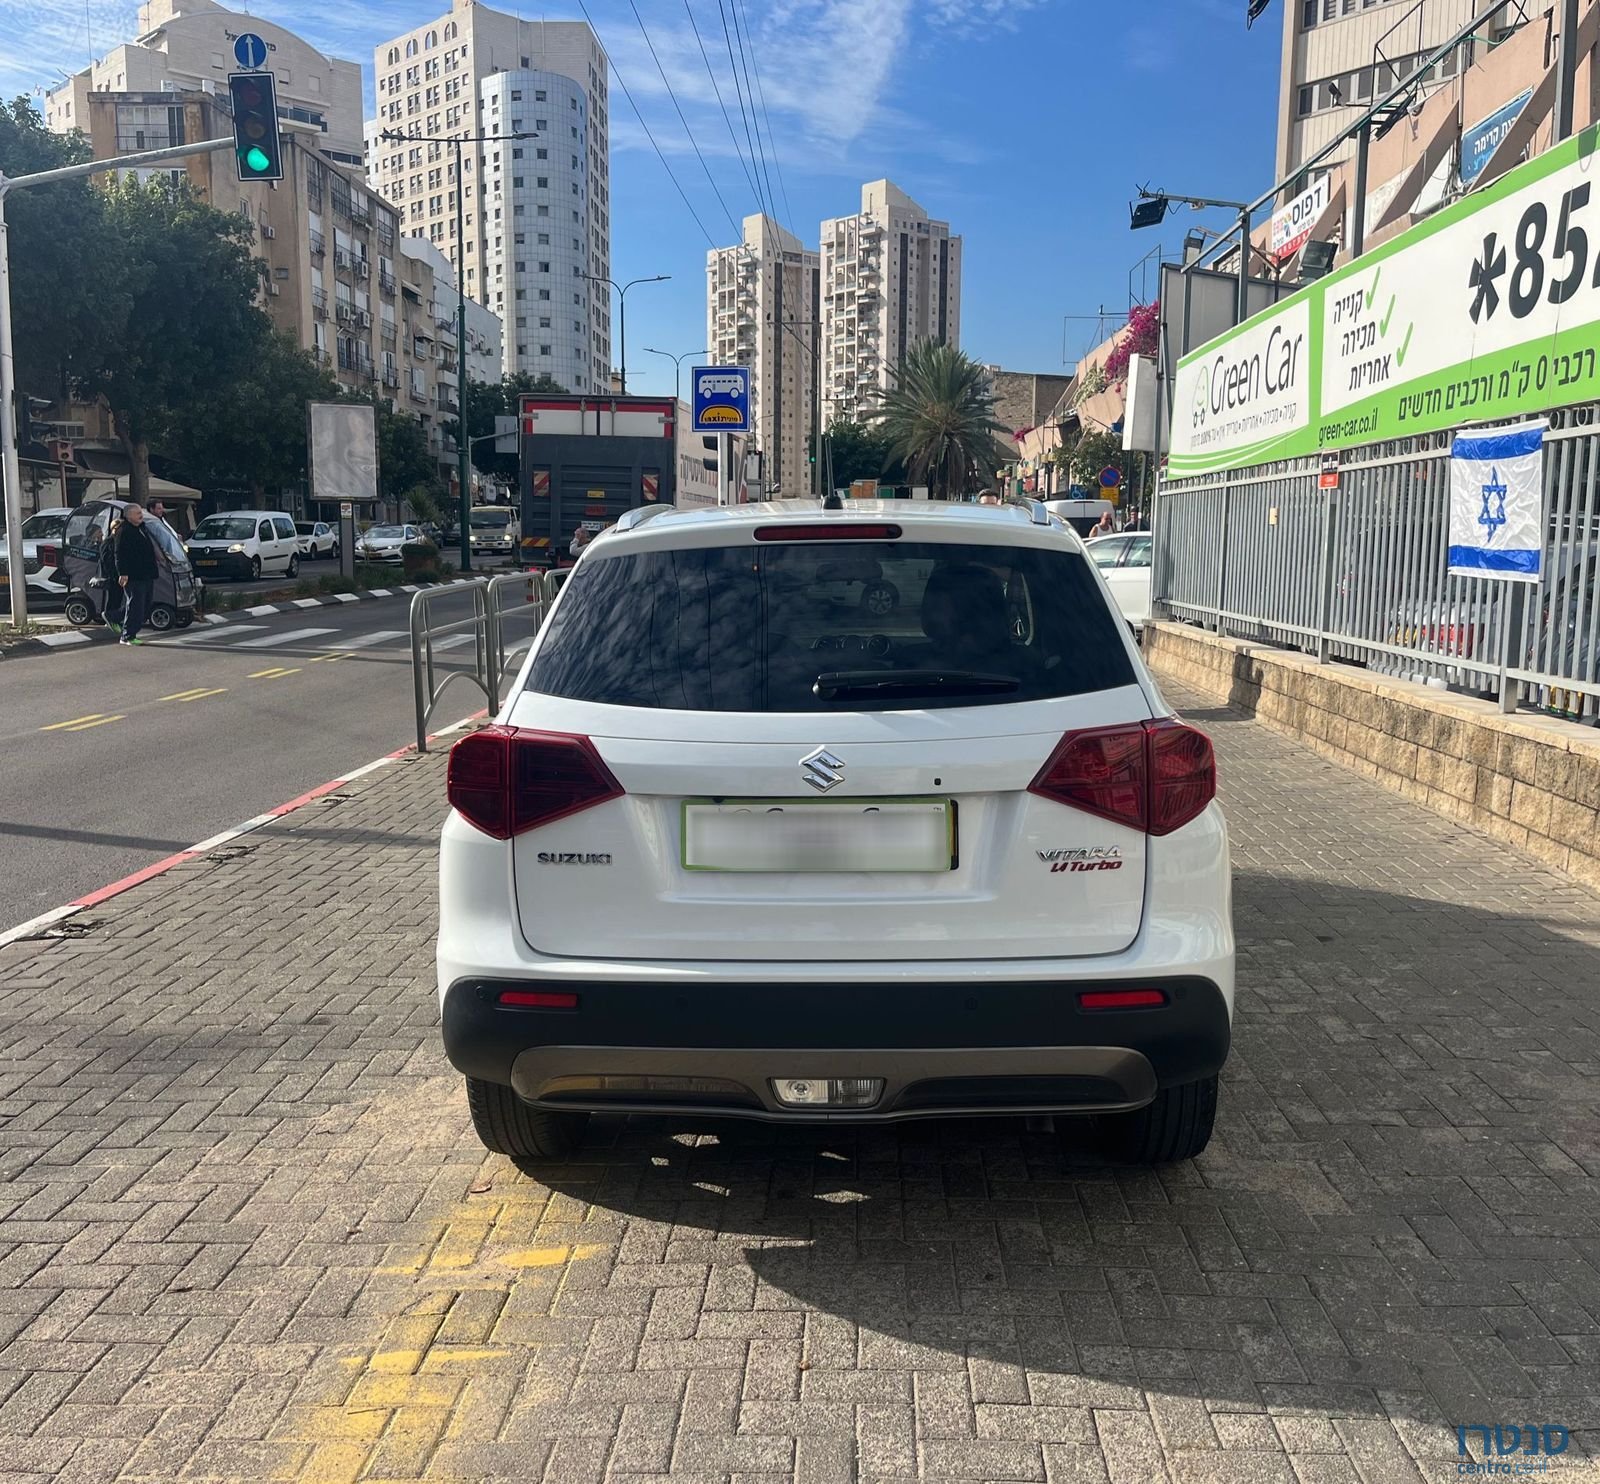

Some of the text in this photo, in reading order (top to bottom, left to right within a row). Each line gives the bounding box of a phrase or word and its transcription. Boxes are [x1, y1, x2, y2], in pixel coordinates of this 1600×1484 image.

[1474, 126, 1499, 156] קדימה
[1292, 186, 1322, 226] דפוס
[1333, 289, 1364, 324] קנייה
[1341, 321, 1376, 357] מכירה
[1210, 325, 1302, 415] Green Car
[1348, 353, 1392, 391] אחריות
[1536, 354, 1548, 391] 0
[1553, 348, 1595, 386] רכבי
[1398, 388, 1442, 421] חדשים
[1445, 374, 1494, 410] ורכבים
[1318, 407, 1379, 448] green-car.co.il
[537, 852, 612, 865] SUZUKI
[1036, 845, 1122, 862] VITARA
[1070, 860, 1123, 872] Turbo
